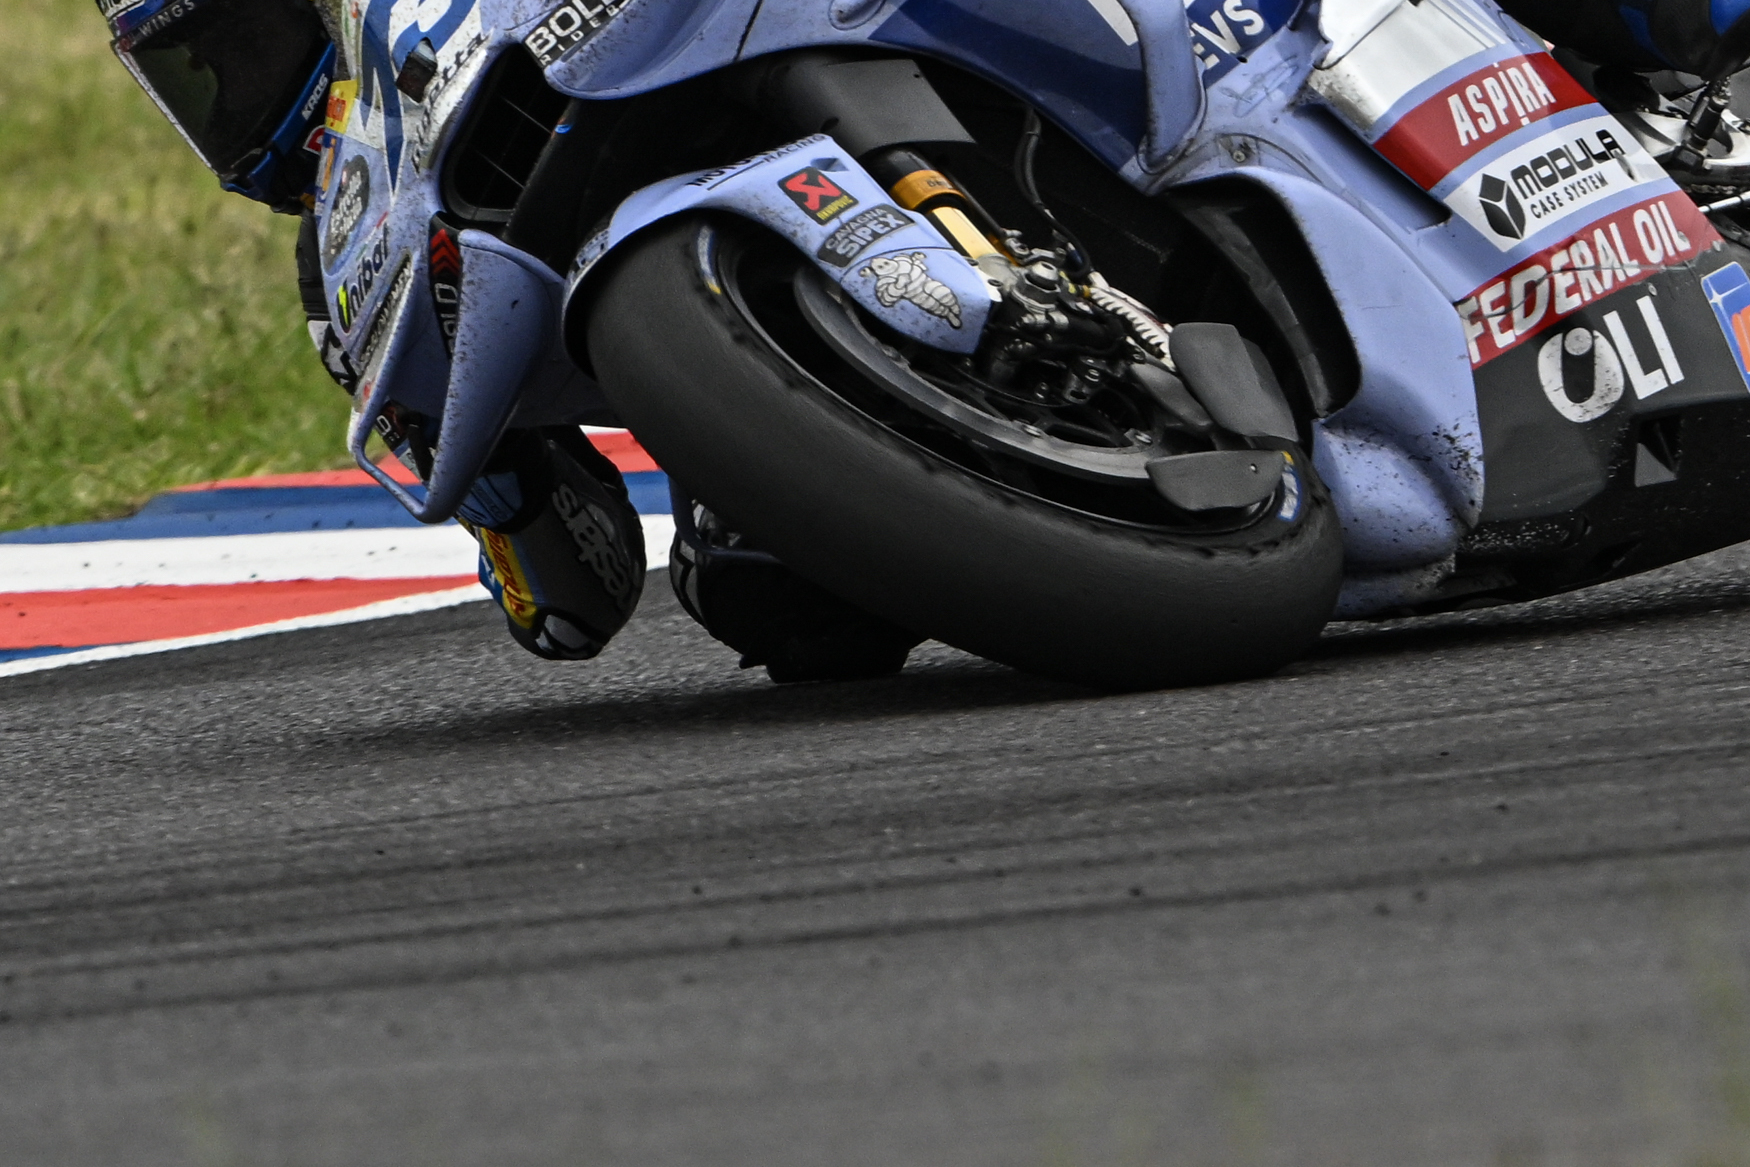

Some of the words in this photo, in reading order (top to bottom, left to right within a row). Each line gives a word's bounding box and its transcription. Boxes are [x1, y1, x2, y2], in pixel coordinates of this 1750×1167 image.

[1447, 62, 1556, 147] ASPIRA
[1511, 128, 1625, 200] MODULA
[1530, 195, 1564, 220] CASE
[1565, 170, 1609, 203] SYSTEM
[825, 207, 887, 250] CAVAGNA
[837, 213, 905, 258] SIPEX
[1457, 222, 1638, 365] FEDERAL
[1633, 200, 1692, 265] OIL
[1537, 295, 1685, 424] OLI
